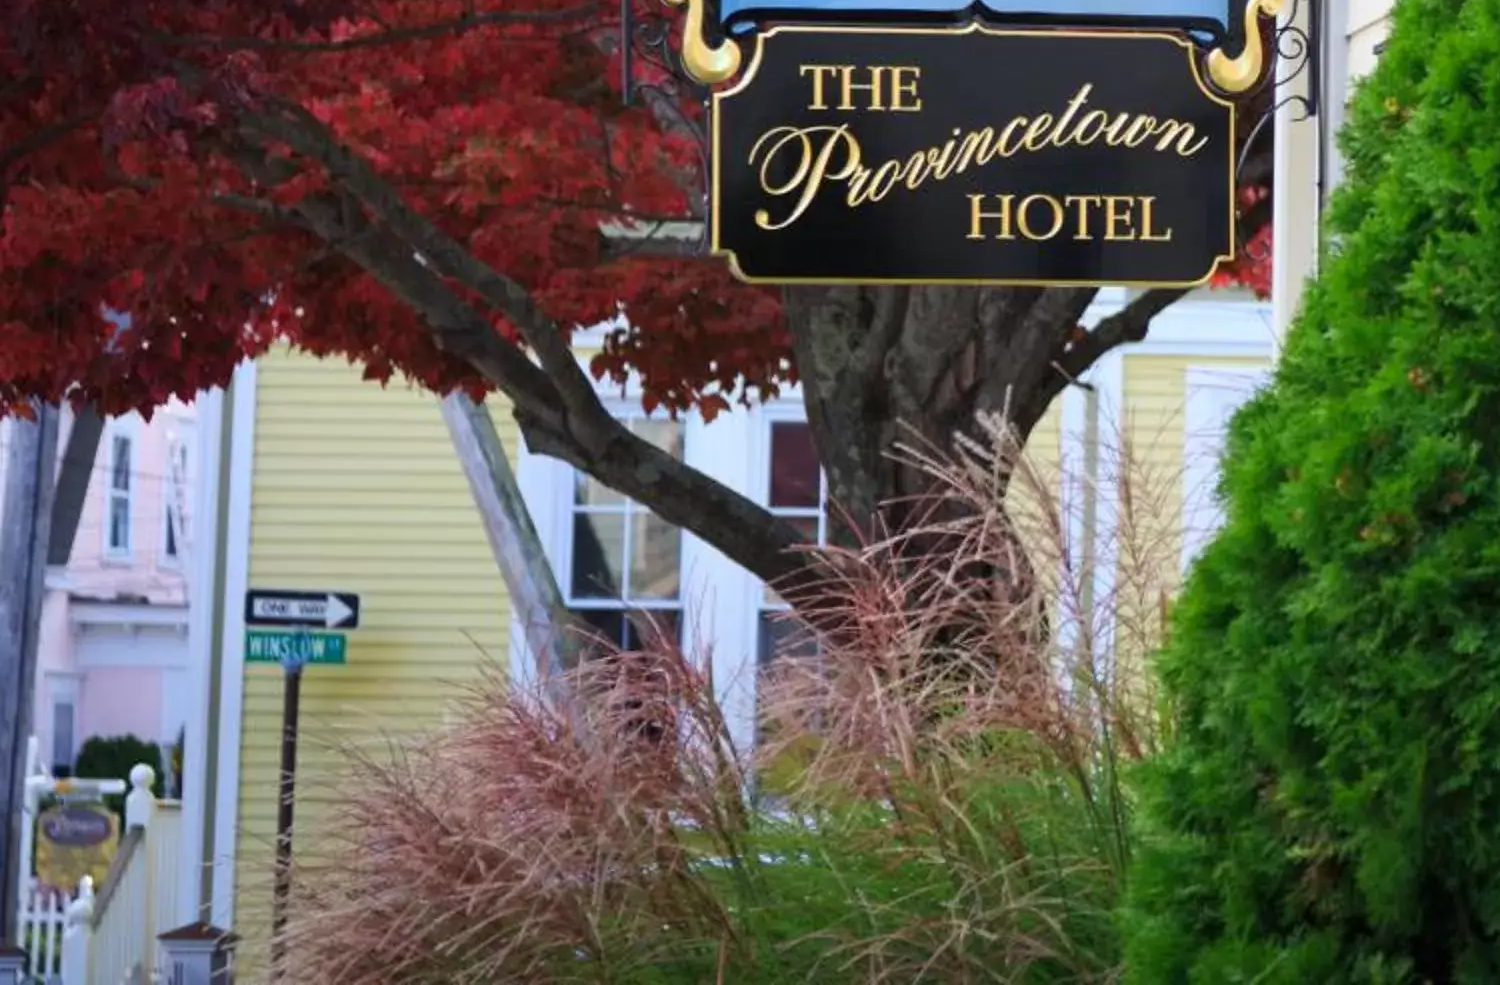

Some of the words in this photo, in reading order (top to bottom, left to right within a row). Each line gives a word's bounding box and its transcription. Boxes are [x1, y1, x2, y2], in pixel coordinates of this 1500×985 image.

[799, 65, 922, 112] THE
[748, 83, 1209, 230] Provincetown
[965, 193, 1171, 241] HOTEL
[249, 635, 325, 660] WINSLOW
